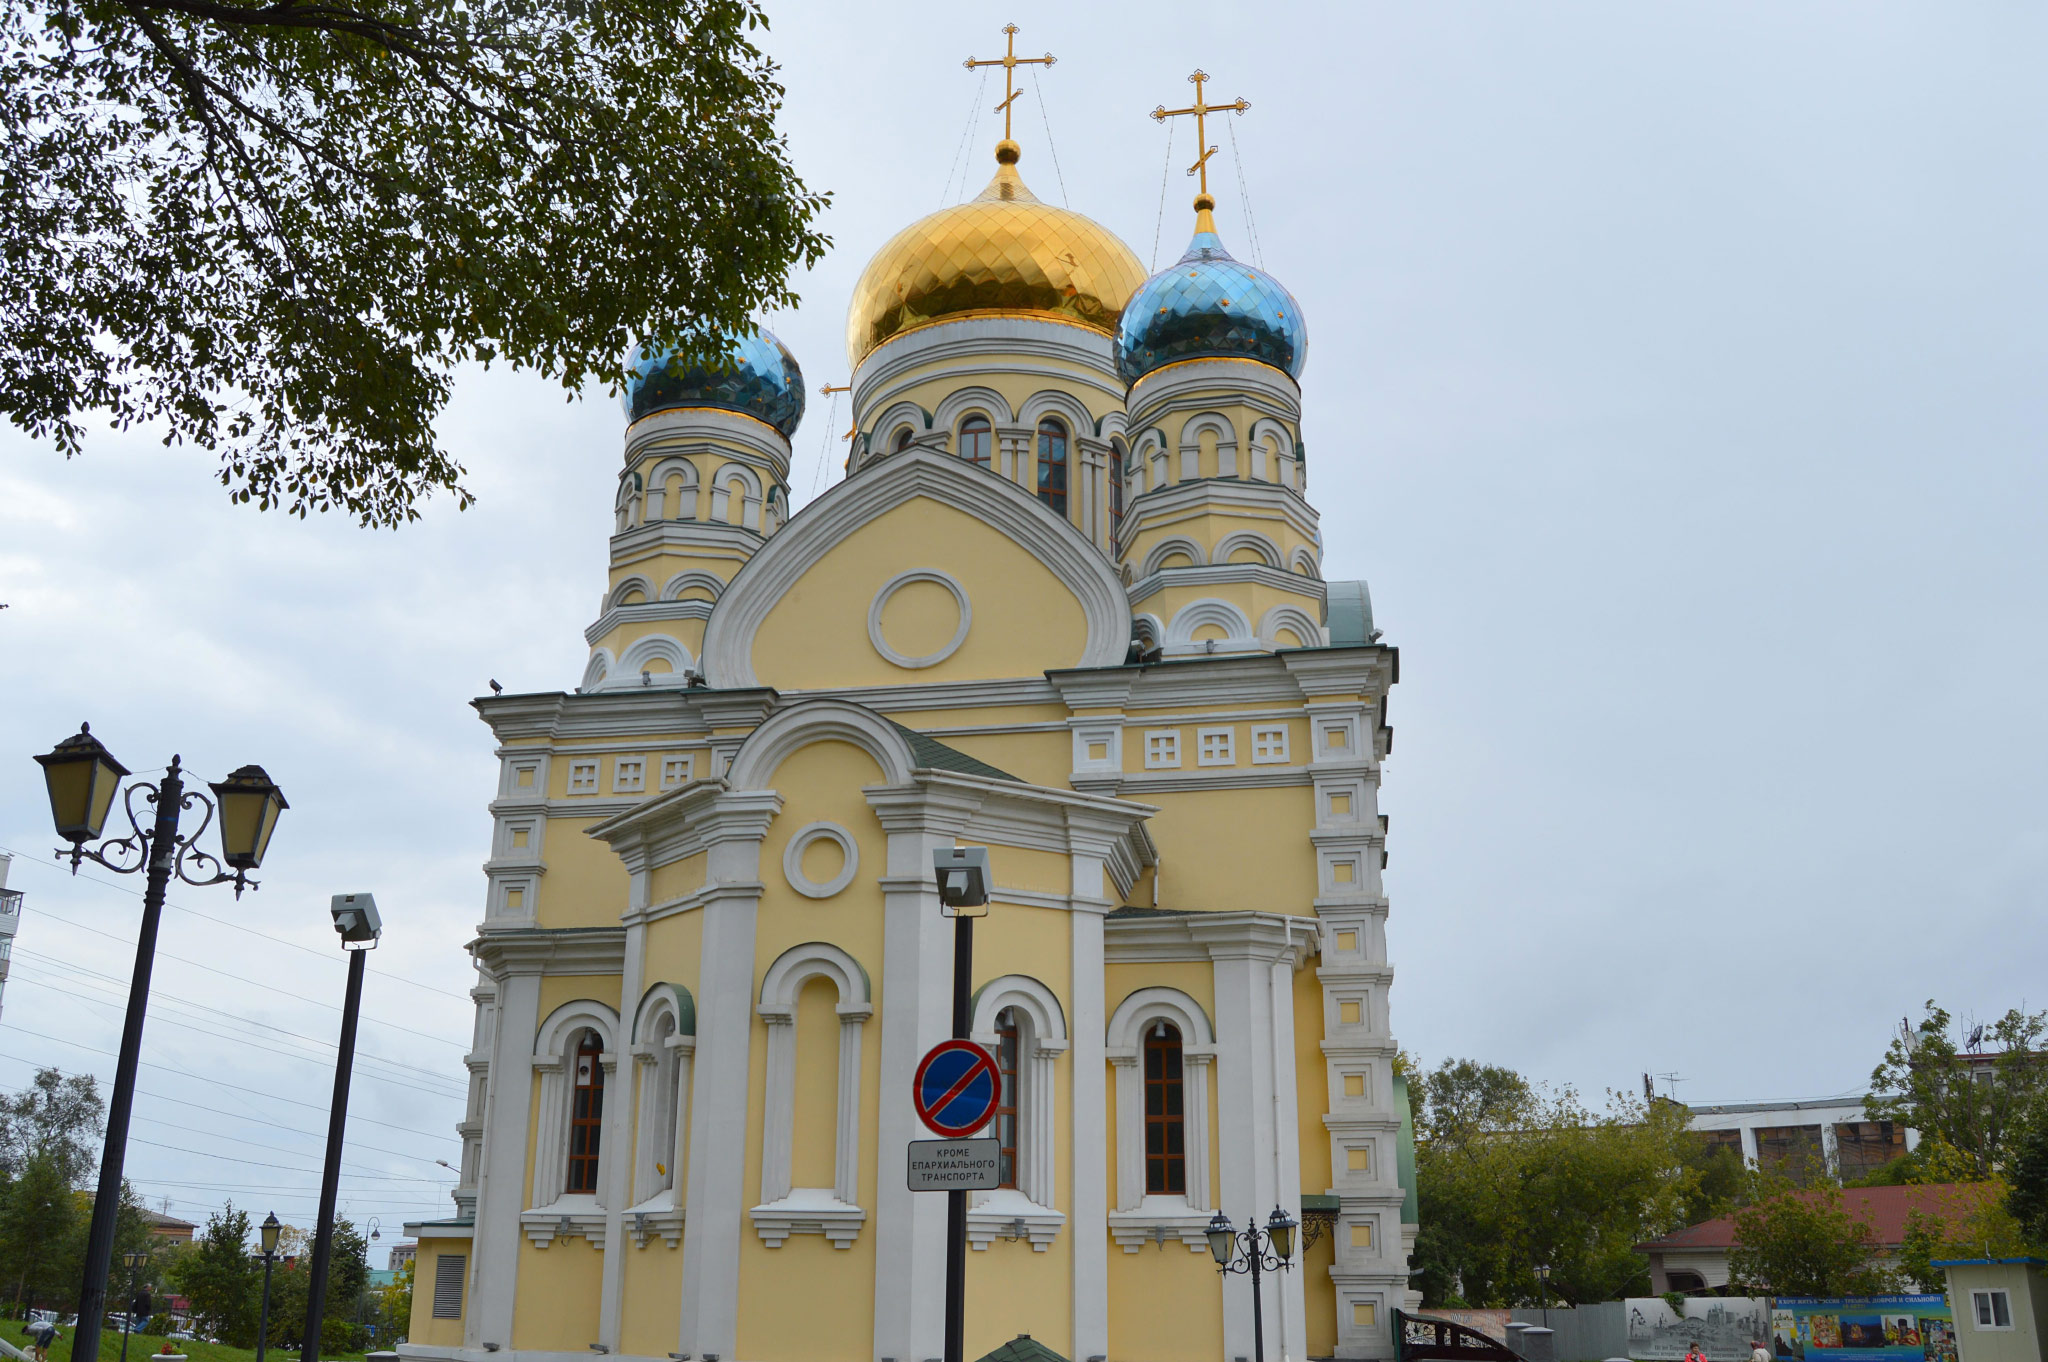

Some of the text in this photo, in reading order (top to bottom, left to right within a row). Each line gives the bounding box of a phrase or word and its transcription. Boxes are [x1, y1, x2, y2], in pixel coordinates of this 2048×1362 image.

[936, 1148, 970, 1158] КРОМЕ
[912, 1159, 995, 1170] ЕПАРХИАЛЬНОГО
[921, 1172, 985, 1182] ТРАНСПОРТА
